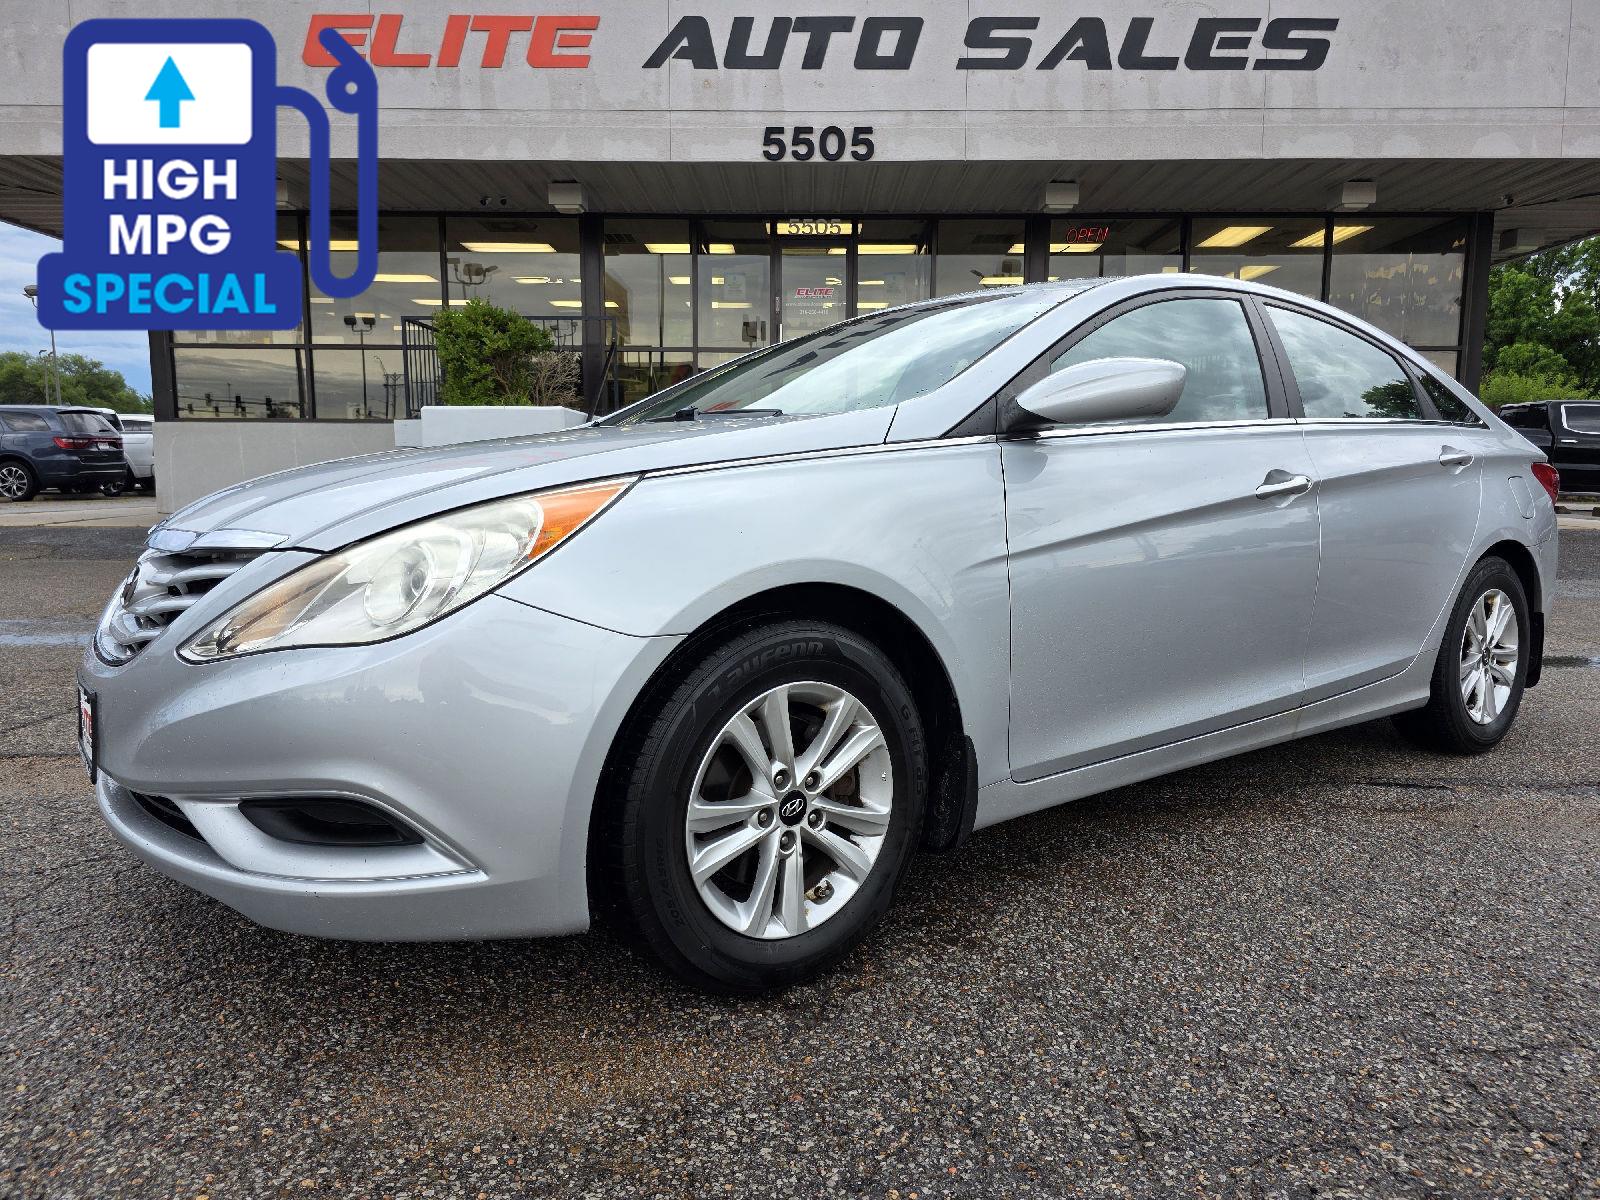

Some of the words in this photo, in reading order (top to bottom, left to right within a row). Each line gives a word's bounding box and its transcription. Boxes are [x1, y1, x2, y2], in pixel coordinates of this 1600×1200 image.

[302, 14, 600, 69] ELITE
[641, 16, 925, 70] AUTO
[956, 16, 1340, 71] SALES
[762, 126, 875, 162] 5505
[787, 219, 842, 235] 5505
[1066, 227, 1109, 243] OPEN
[795, 288, 834, 296] ELITE
